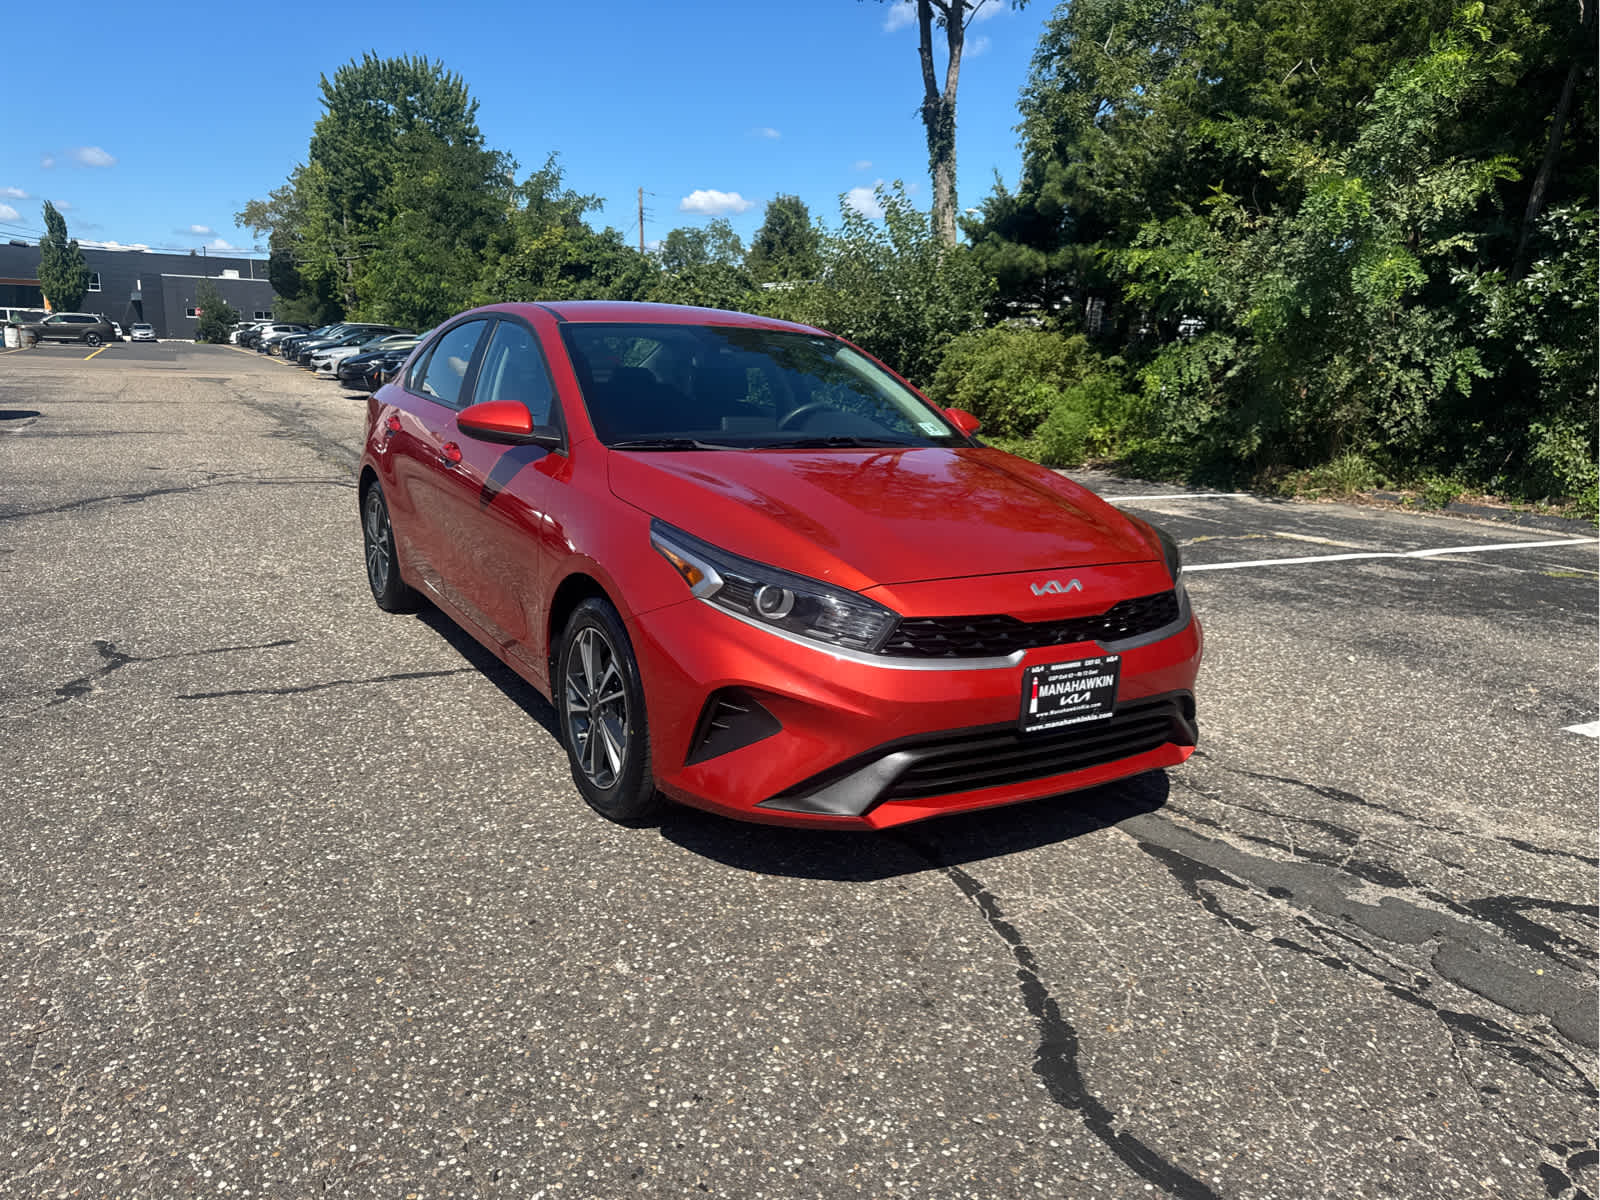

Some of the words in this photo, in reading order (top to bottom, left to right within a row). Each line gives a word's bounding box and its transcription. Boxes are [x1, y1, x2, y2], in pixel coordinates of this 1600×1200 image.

[1030, 578, 1083, 596] KIA
[1039, 674, 1114, 697] MANAHAWKIN
[1059, 691, 1091, 706] KIA
